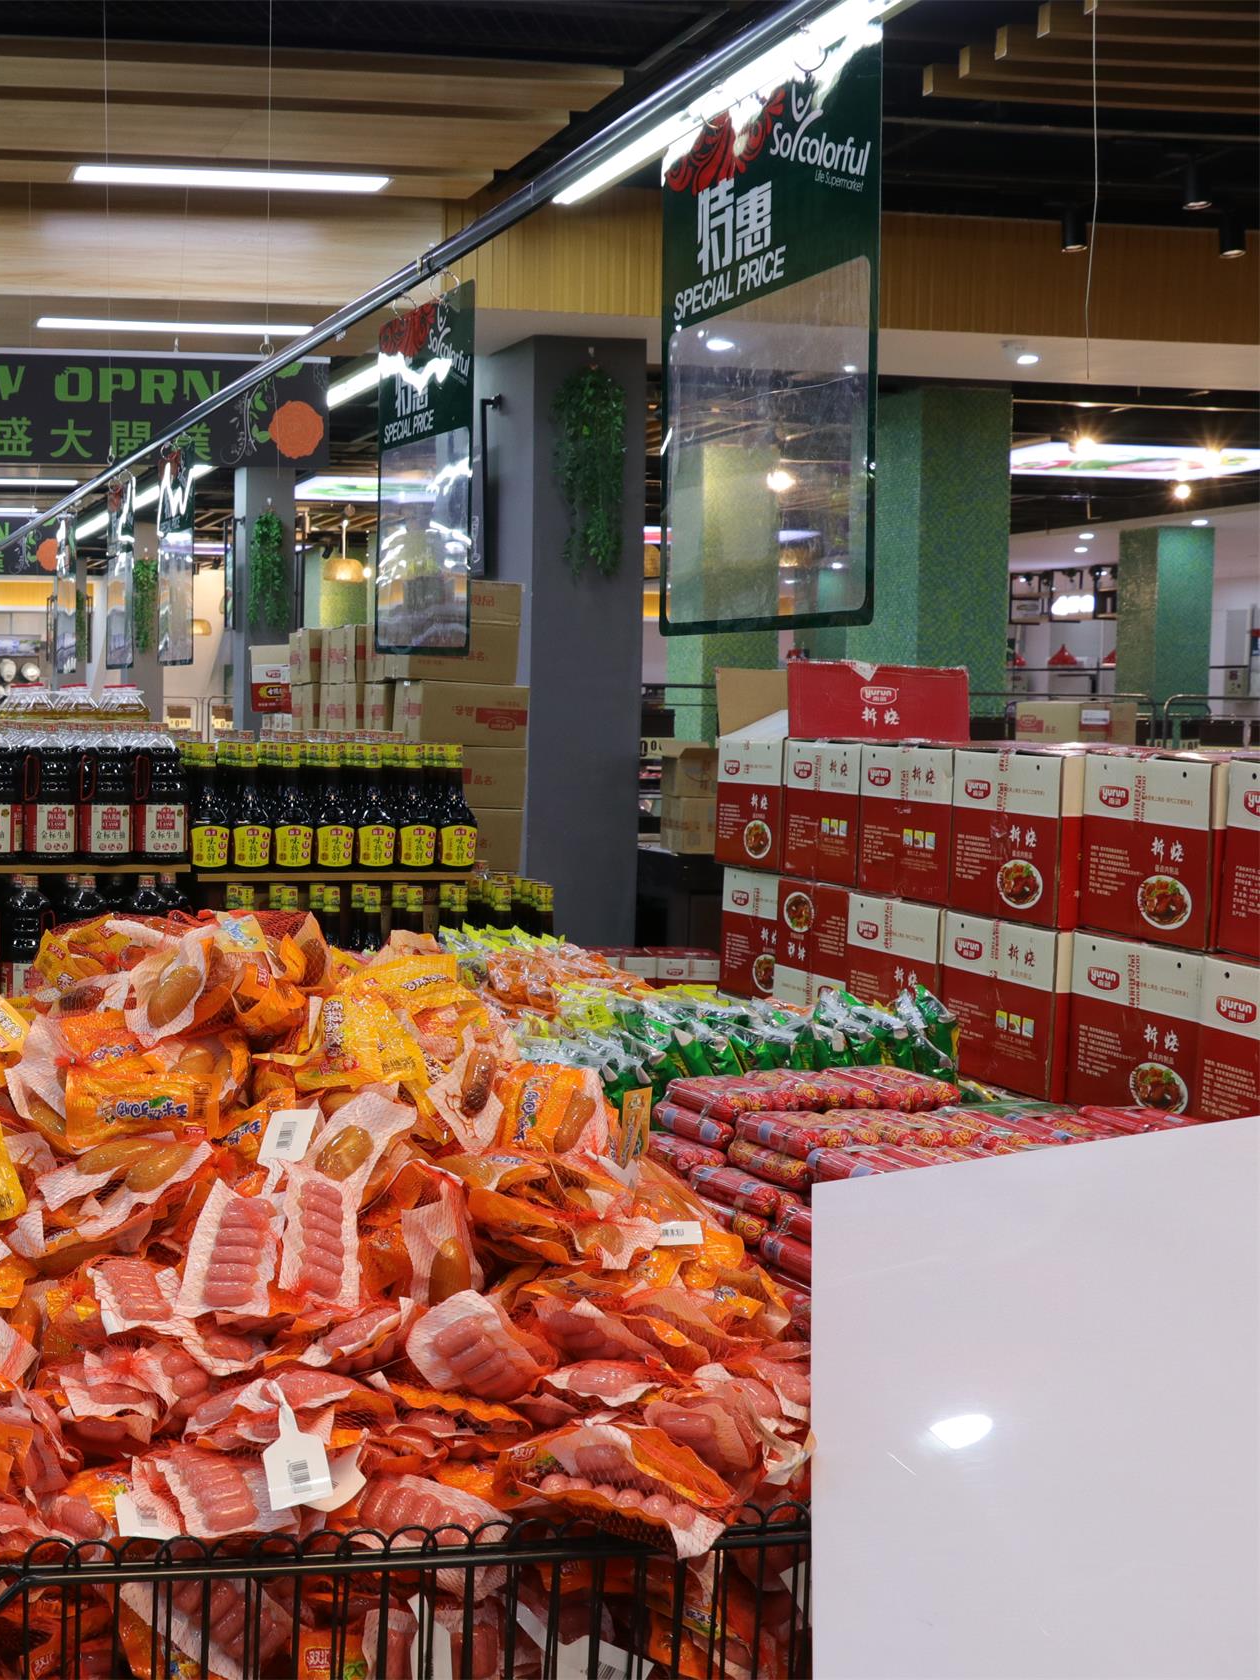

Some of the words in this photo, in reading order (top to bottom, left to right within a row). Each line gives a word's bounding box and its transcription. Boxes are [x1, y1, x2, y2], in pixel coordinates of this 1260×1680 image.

[697, 177, 772, 276] 特惠
[674, 270, 735, 321] SPECIAL
[736, 245, 786, 295] PRICE
[54, 366, 220, 405] OPRN
[384, 417, 412, 444] SPECIAL
[412, 409, 434, 434] PRICE
[967, 781, 989, 792] yurun
[1102, 787, 1127, 801] yurun
[956, 939, 980, 951] yurun
[1090, 968, 1117, 982] yurun
[1220, 997, 1254, 1014] yurun
